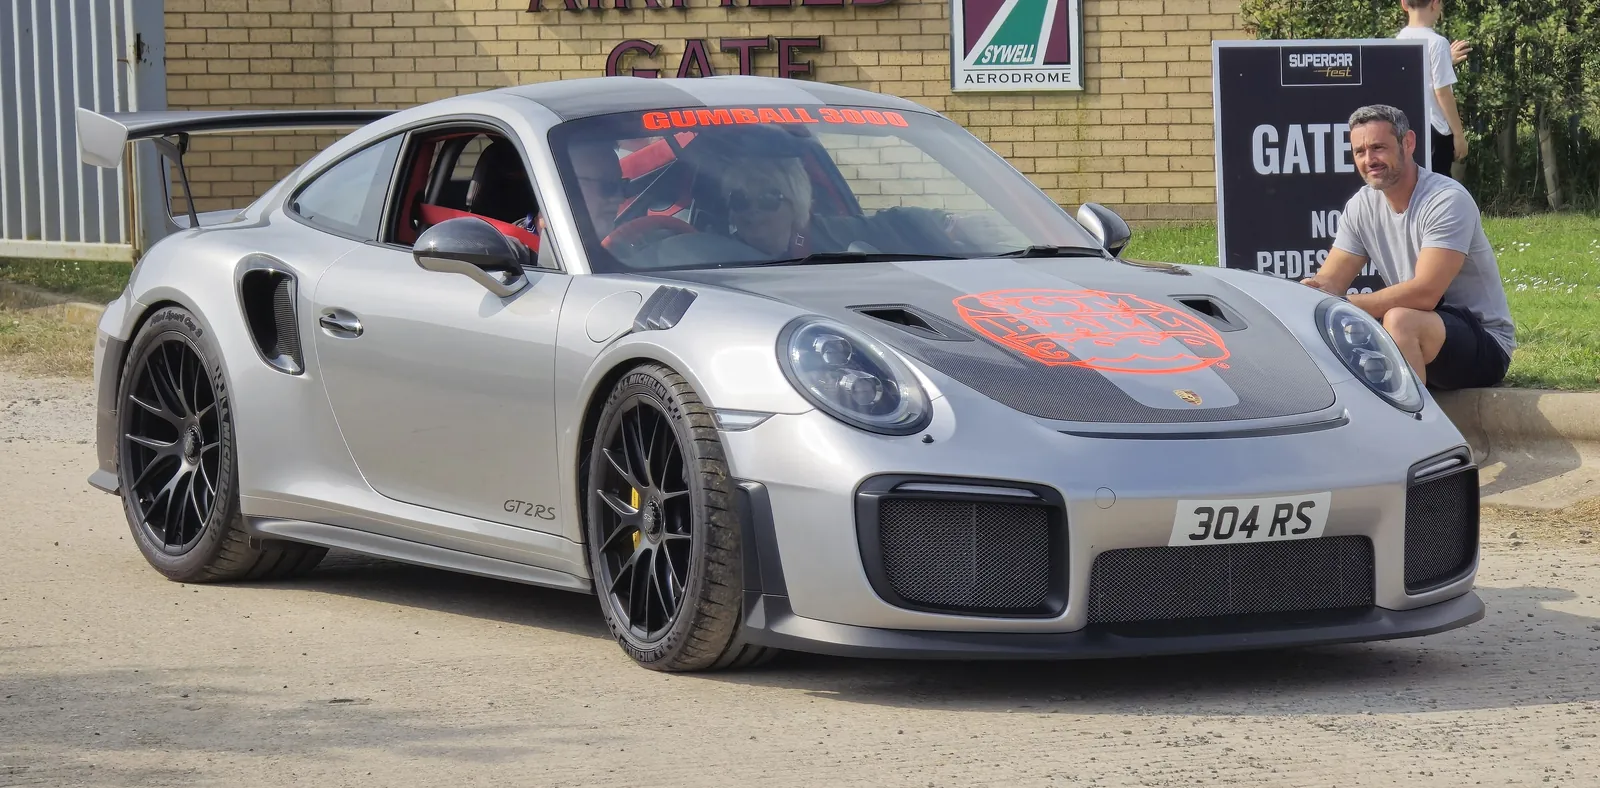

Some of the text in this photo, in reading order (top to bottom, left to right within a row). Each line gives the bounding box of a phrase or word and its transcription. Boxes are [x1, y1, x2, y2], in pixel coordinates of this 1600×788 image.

[605, 36, 824, 79] GATE
[981, 44, 1035, 63] SYWELL
[1289, 53, 1353, 67] SUPERCAR
[964, 72, 1071, 84] AERODROME
[1325, 66, 1353, 77] fest
[642, 107, 909, 130] GUMBALL 3000
[1252, 123, 1355, 175] GATE
[1311, 209, 1341, 239] NO
[628, 373, 667, 400] MICHELIN
[216, 420, 231, 515] MICHELIN
[1188, 500, 1316, 541] 304 RS
